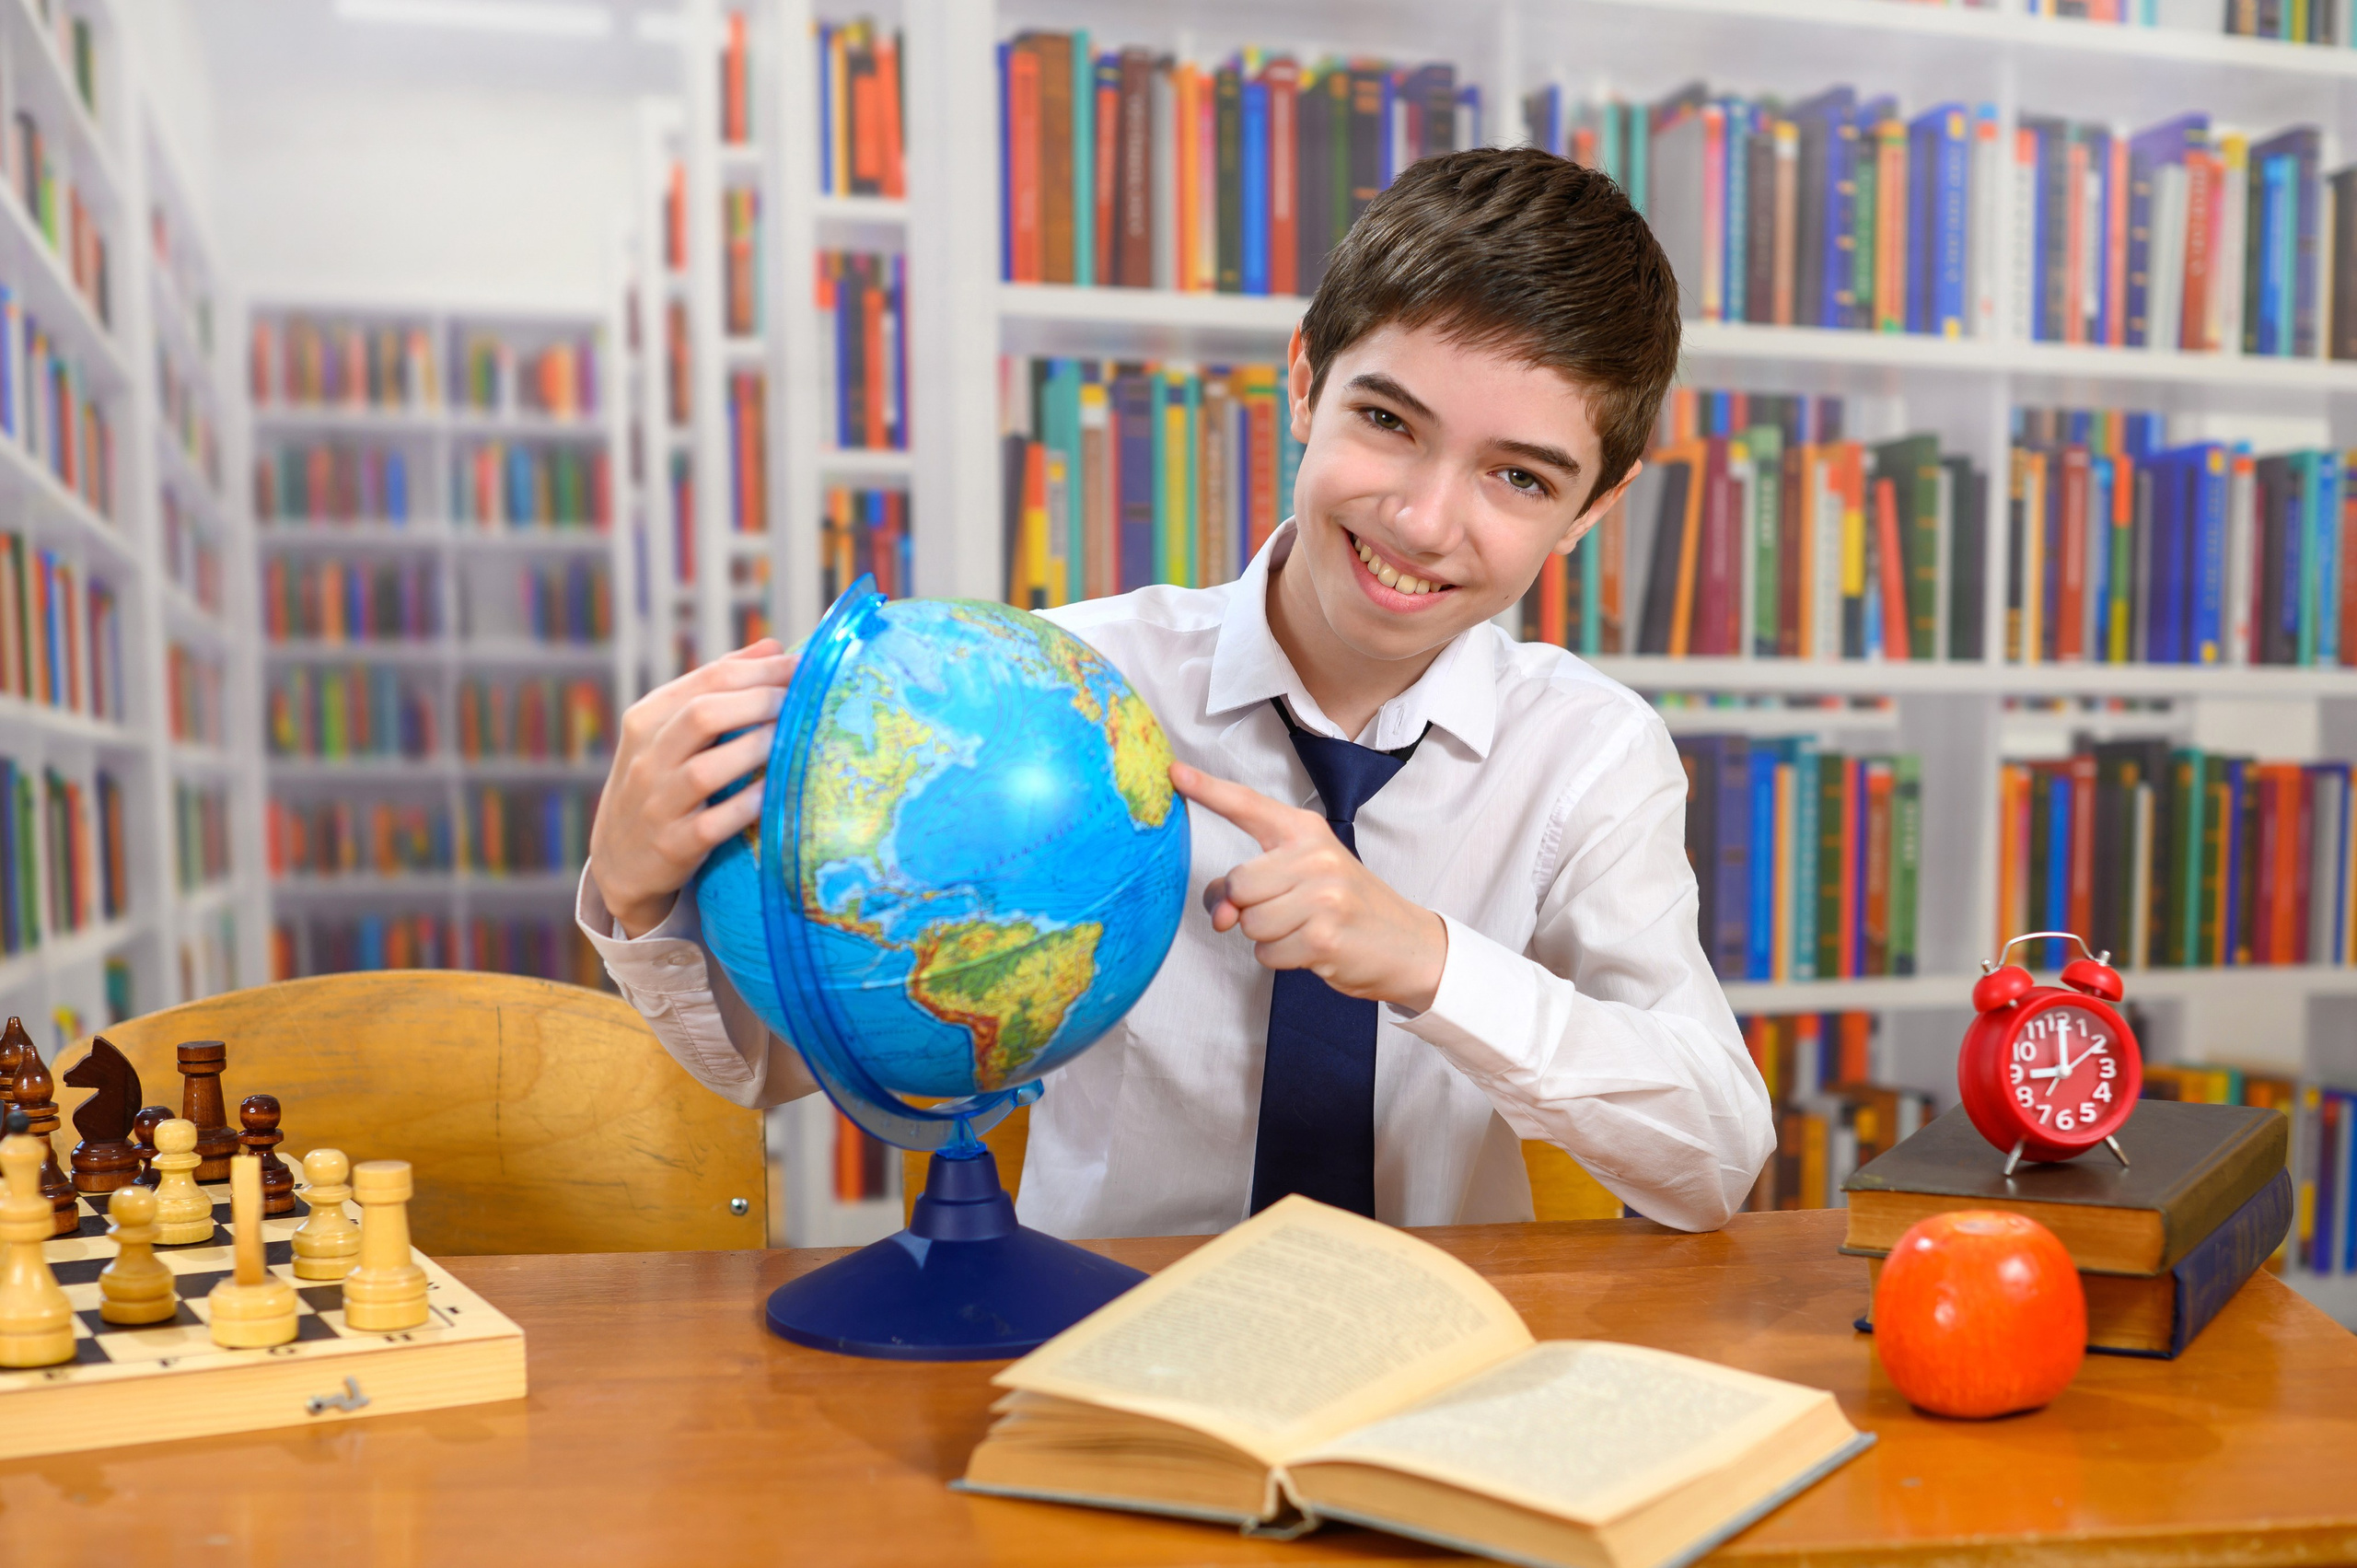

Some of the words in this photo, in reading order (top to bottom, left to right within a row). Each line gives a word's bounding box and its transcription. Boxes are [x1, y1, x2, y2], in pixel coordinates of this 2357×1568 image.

[2026, 1020, 2046, 1040] 11
[2044, 1012, 2073, 1031] 12
[2075, 1018, 2087, 1038] 1
[2013, 1040, 2037, 1062] 10
[2091, 1034, 2108, 1054] 2
[2009, 1063, 2025, 1085] 9
[2098, 1057, 2117, 1078] 3
[2014, 1086, 2035, 1108] 8
[2092, 1081, 2112, 1103] 4
[2036, 1104, 2052, 1124] 7
[2055, 1109, 2075, 1131] 6
[2079, 1102, 2097, 1122] 5
